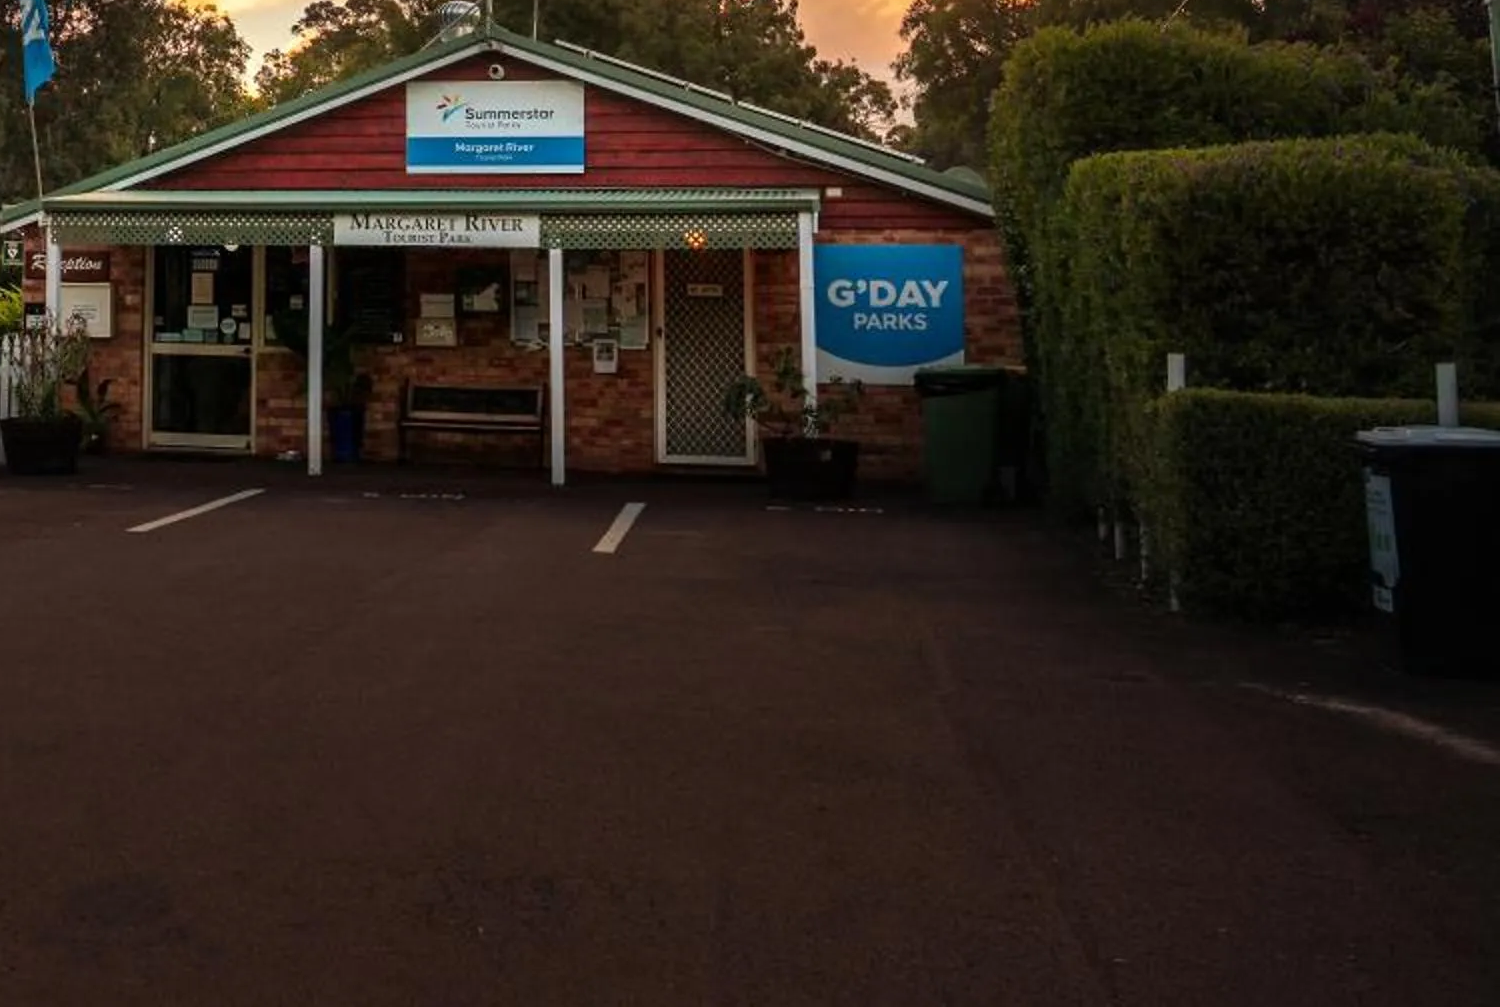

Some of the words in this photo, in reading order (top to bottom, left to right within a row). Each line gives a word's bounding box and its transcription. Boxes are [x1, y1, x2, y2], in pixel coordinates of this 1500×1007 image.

[464, 107, 554, 120] Summerstar
[455, 142, 504, 153] Margaret
[505, 142, 534, 152] River
[350, 214, 457, 231] MARGARET
[464, 214, 523, 232] RIVER
[827, 279, 949, 308] G'DAY
[853, 312, 928, 330] PARKS
